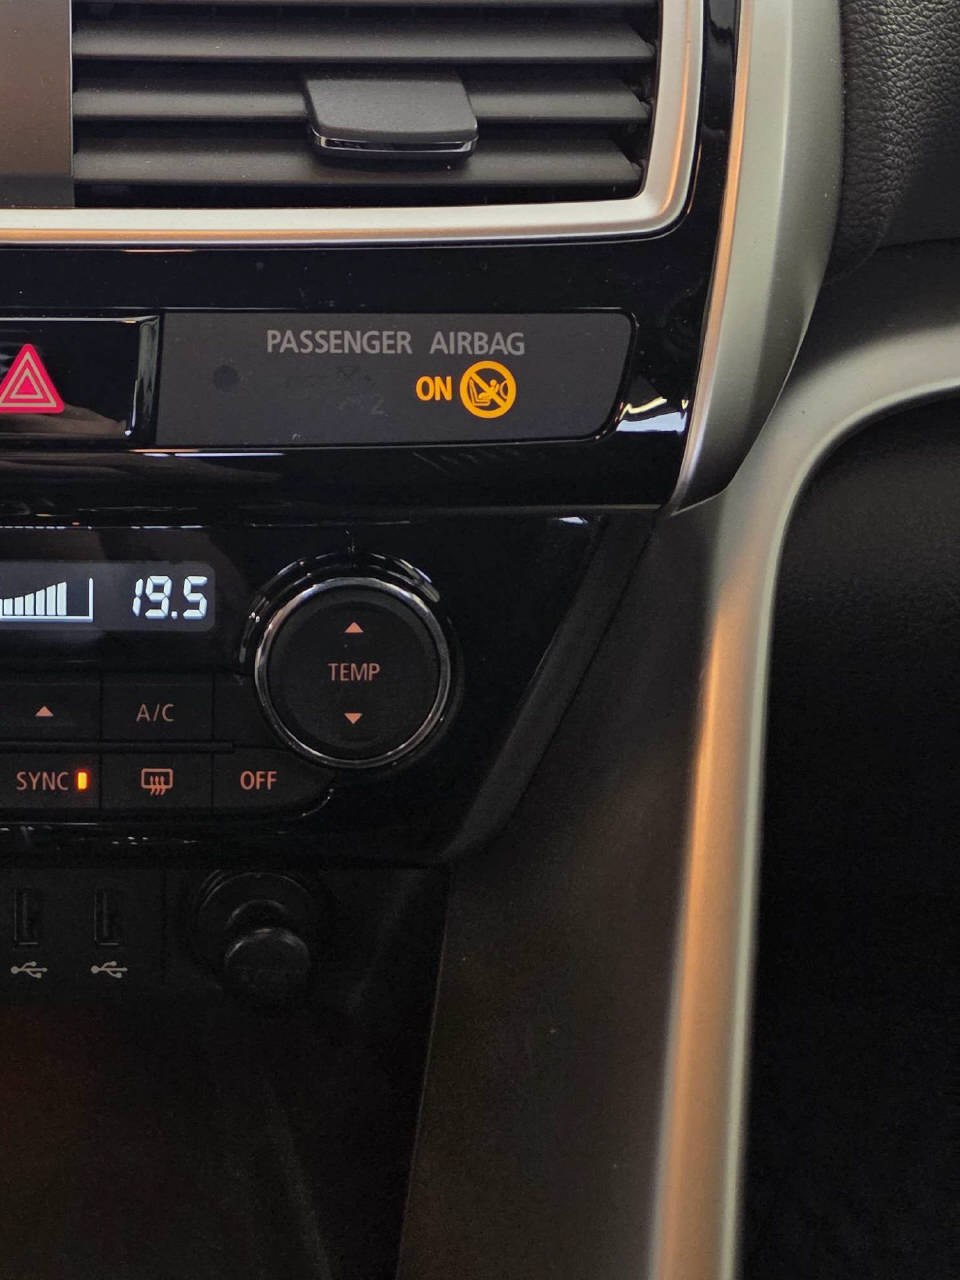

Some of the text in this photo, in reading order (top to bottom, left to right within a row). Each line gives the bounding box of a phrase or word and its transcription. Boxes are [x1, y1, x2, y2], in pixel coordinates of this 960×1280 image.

[266, 330, 526, 356] PASSENGER AIRBAG
[415, 376, 453, 401] ON
[132, 575, 208, 620] 19.5
[328, 663, 381, 682] TEMP
[136, 703, 175, 722] A/C
[16, 771, 69, 791] SYNC
[240, 771, 278, 791] OFF
